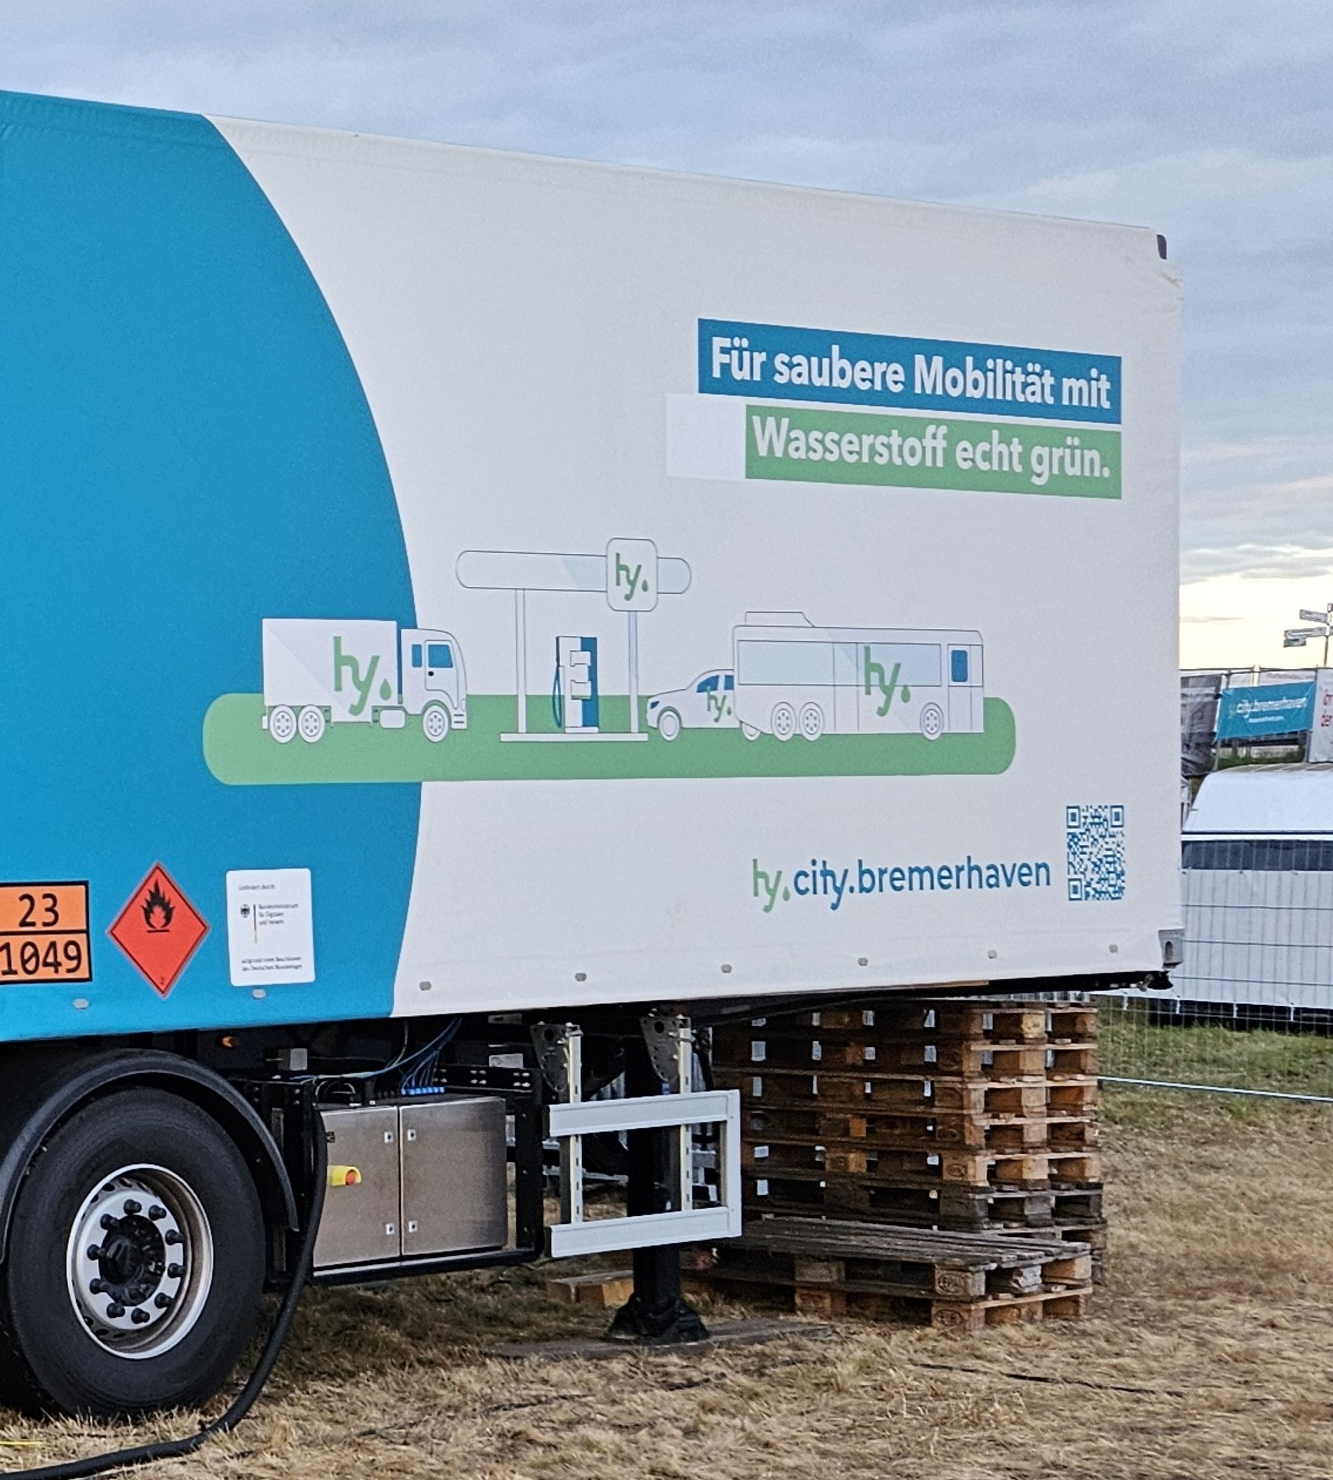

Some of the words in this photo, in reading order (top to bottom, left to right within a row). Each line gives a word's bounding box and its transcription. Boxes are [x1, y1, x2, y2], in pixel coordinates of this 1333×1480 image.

[711, 335, 767, 384] Für
[773, 343, 905, 395] saubere
[913, 353, 1054, 406] Mobilität
[1061, 366, 1111, 410] mit
[751, 414, 948, 469] Wasserstoff
[955, 429, 1022, 473] echt
[1031, 435, 1111, 485] grün.
[18, 893, 59, 928] 23
[0, 939, 83, 976] 1049
[159, 976, 166, 986] 2
